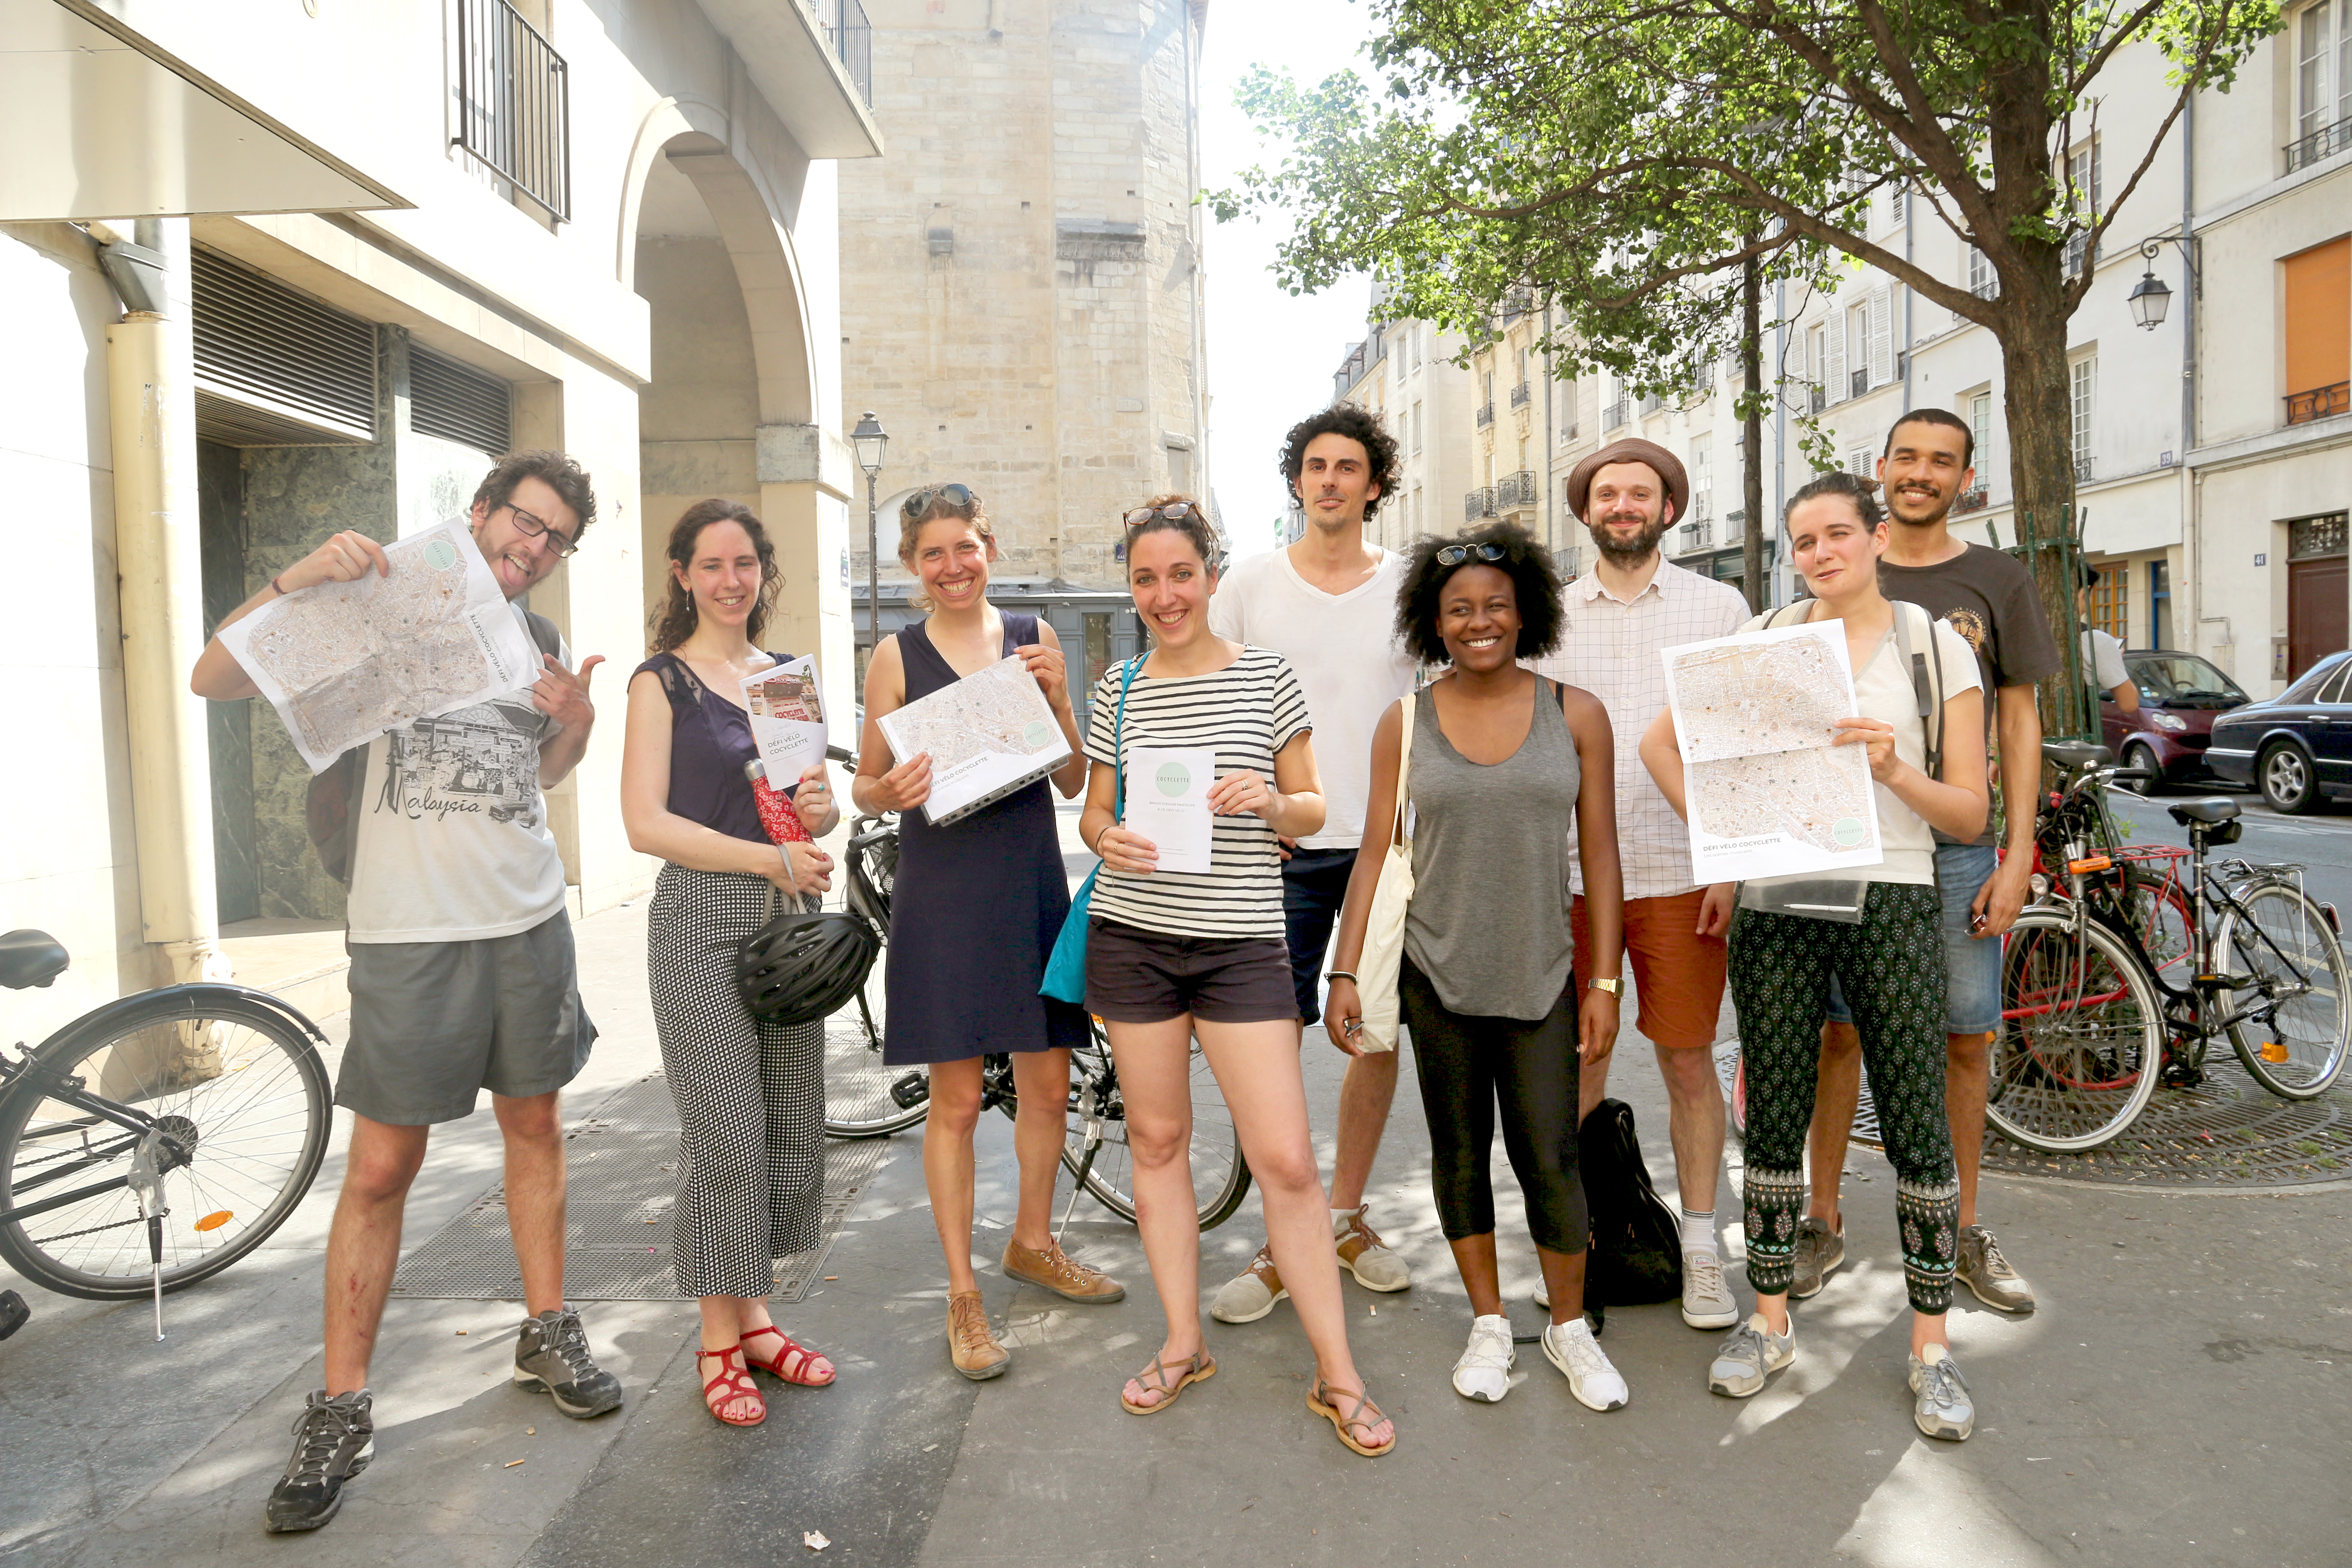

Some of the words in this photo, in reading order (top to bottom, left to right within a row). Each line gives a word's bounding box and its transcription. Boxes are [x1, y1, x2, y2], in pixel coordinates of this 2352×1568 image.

[2162, 453, 2171, 465] 39
[431, 542, 448, 568] COCYCLETTE
[2255, 555, 2264, 565] 41
[470, 613, 492, 652] COCYCLETTE
[490, 636, 503, 657] musicales
[490, 652, 500, 669] VÉLO
[498, 669, 508, 683] DÉFI
[775, 708, 805, 718] COCYCLETTE
[768, 740, 783, 748] DÉFI
[783, 733, 800, 742] VÉLO
[1026, 727, 1047, 740] COCYCLETTE
[769, 737, 808, 755] COCYCLETTE
[940, 773, 955, 783] VÉLO
[955, 756, 988, 775] COCYCLETTE
[951, 774, 969, 785] musicales
[374, 767, 481, 822] Malaysia
[1739, 838, 1781, 848] COCYCLETTE
